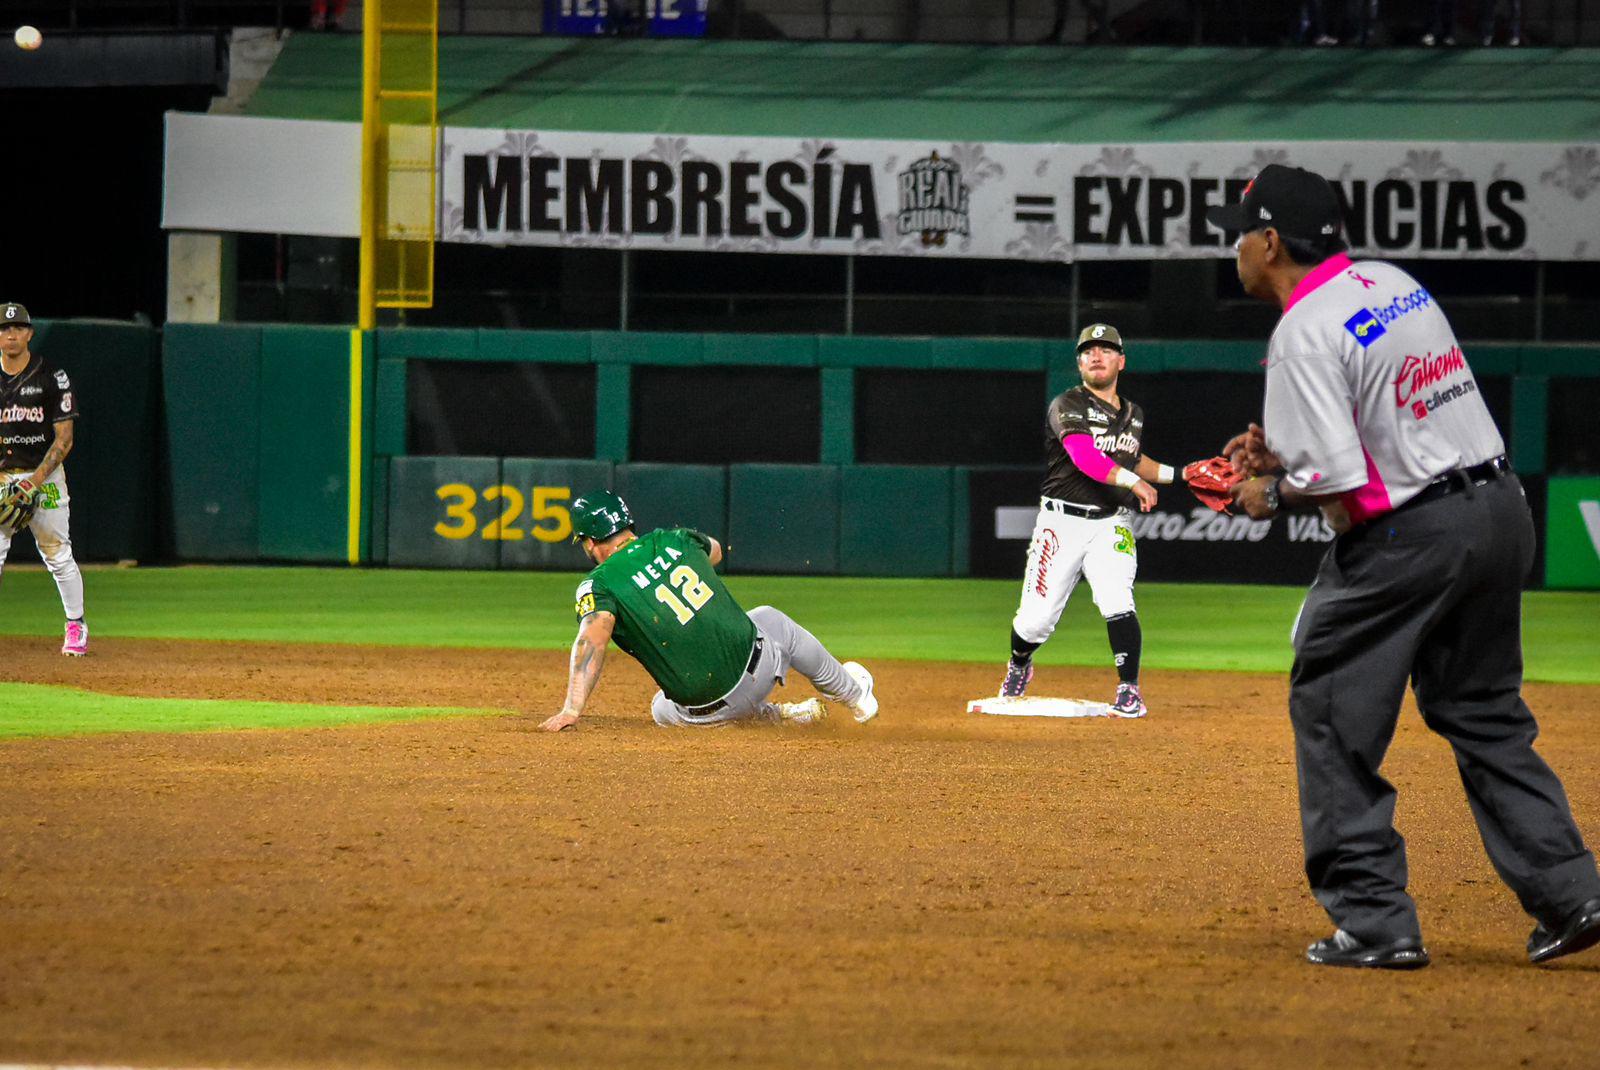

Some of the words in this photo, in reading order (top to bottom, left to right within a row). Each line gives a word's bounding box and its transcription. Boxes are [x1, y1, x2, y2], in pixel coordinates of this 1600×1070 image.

[462, 147, 882, 240] MEMBRESÍA
[1074, 176, 1527, 251] EXPENCIAS
[0, 433, 46, 445] anCoppel
[434, 483, 573, 543] 325
[1132, 507, 1272, 541] utoZone
[631, 546, 682, 589] MEZA
[654, 564, 715, 626] 12
